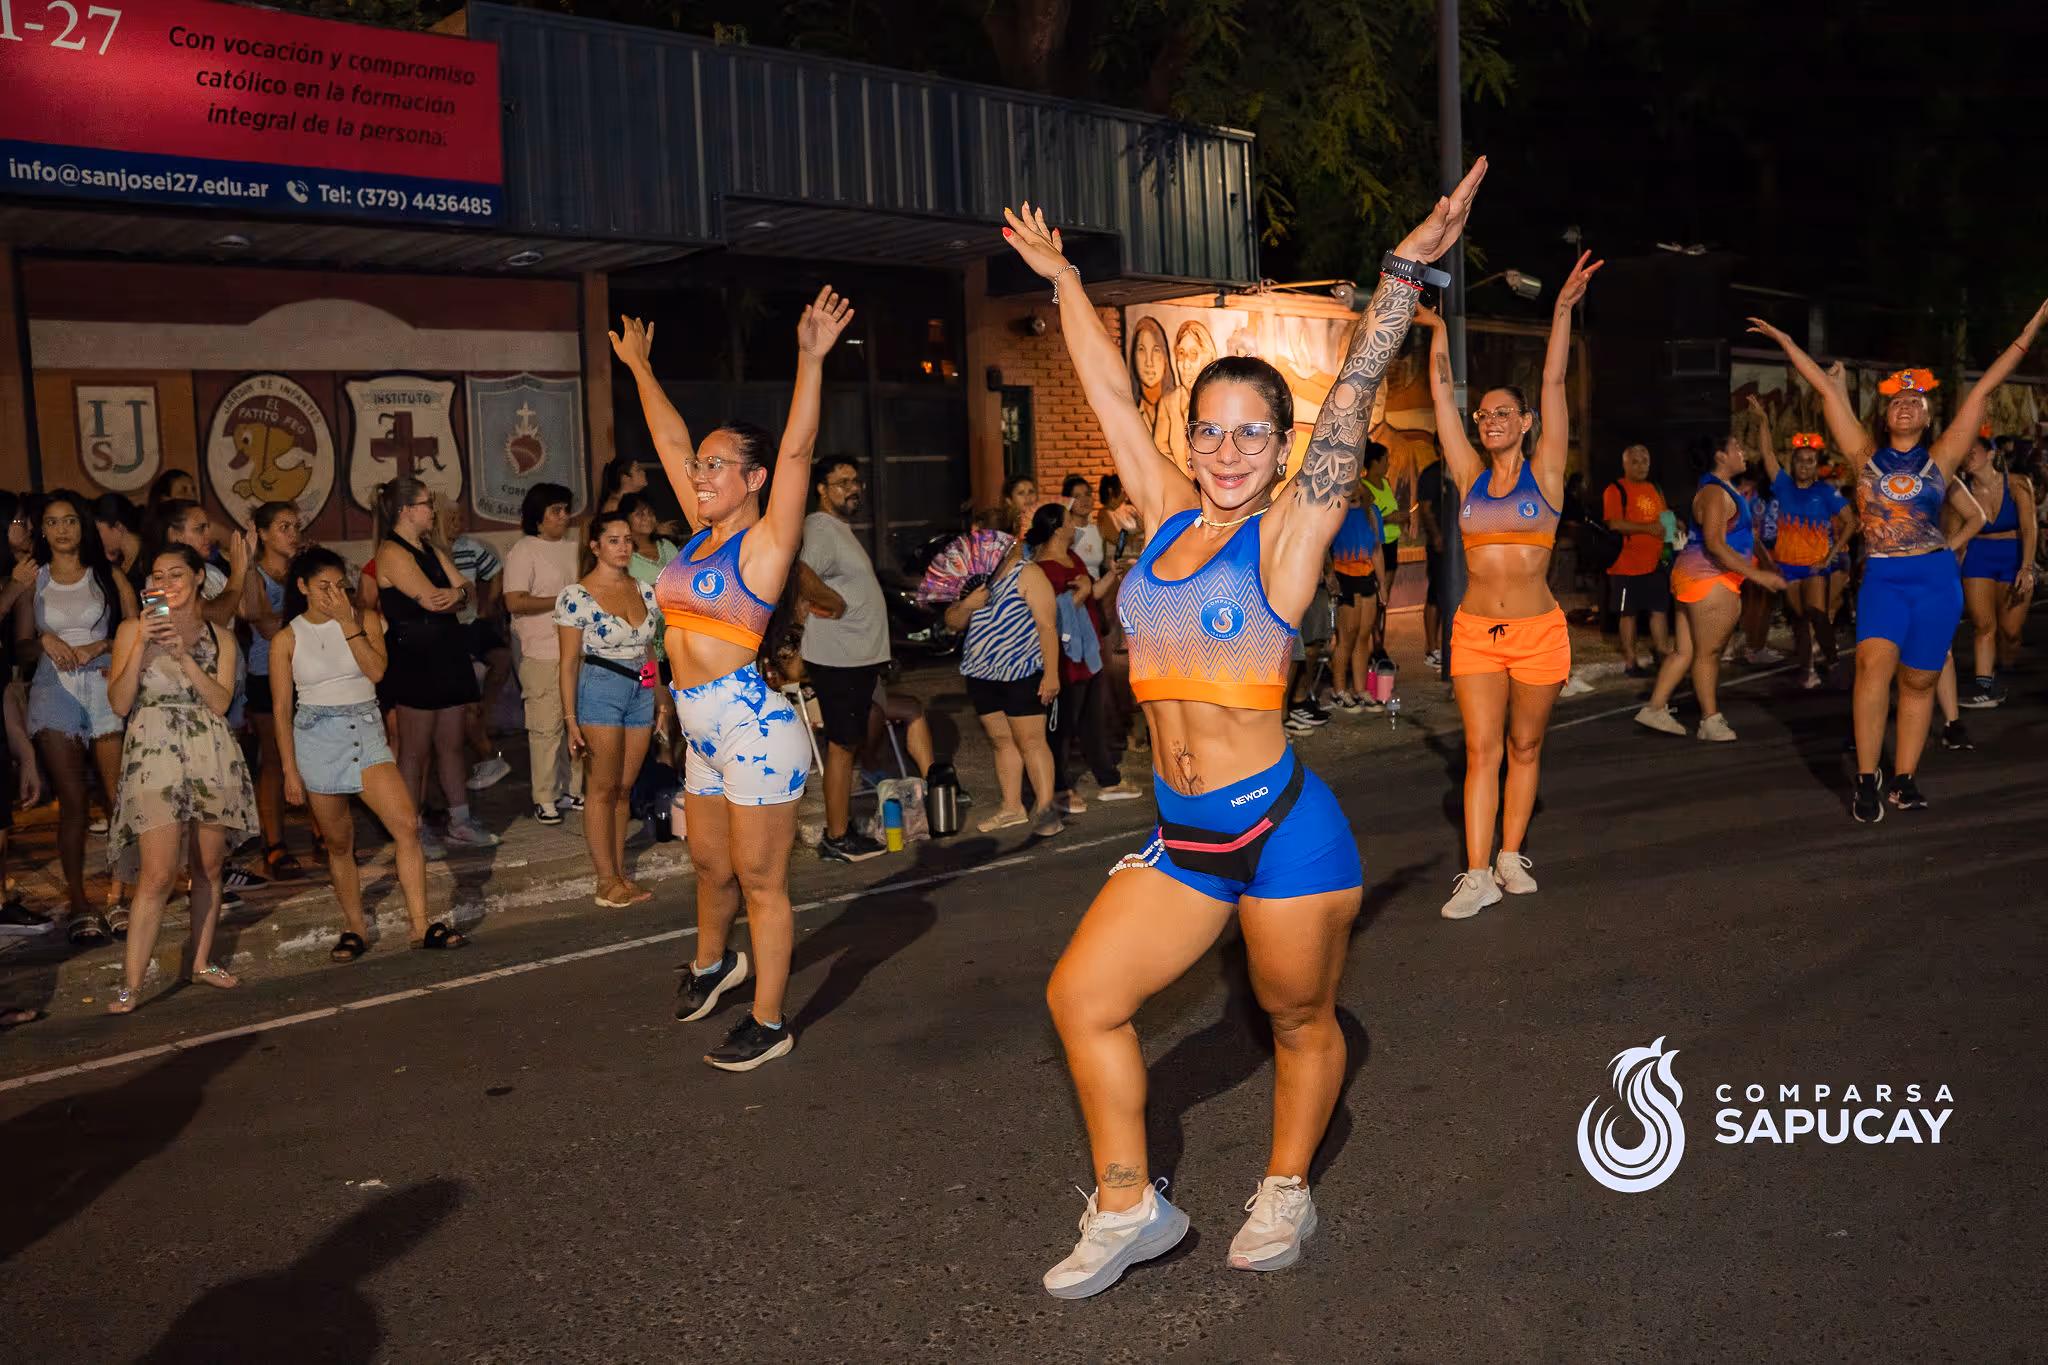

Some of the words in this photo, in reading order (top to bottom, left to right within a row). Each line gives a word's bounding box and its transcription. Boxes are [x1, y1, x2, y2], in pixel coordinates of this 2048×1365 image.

[169, 26, 215, 50] Con
[224, 37, 323, 65] vocación
[329, 51, 342, 70] y
[348, 55, 476, 86] compromiso
[196, 69, 287, 95] católico
[294, 82, 320, 99] en
[326, 80, 345, 101] la
[352, 83, 456, 115] formación
[208, 103, 296, 131] integral
[302, 113, 329, 135] de
[336, 117, 354, 137] la
[360, 122, 448, 147] persona.
[9, 158, 269, 198] info@sanjosei27.edu.ar
[318, 183, 352, 204] Tel:
[356, 188, 407, 211] (379)
[412, 192, 492, 216] 4436485
[266, 398, 280, 410] EL
[374, 392, 431, 405] INSTITUTO
[239, 407, 279, 421] PATITO
[283, 416, 307, 434] FEO
[1230, 786, 1269, 808] NEWOD
